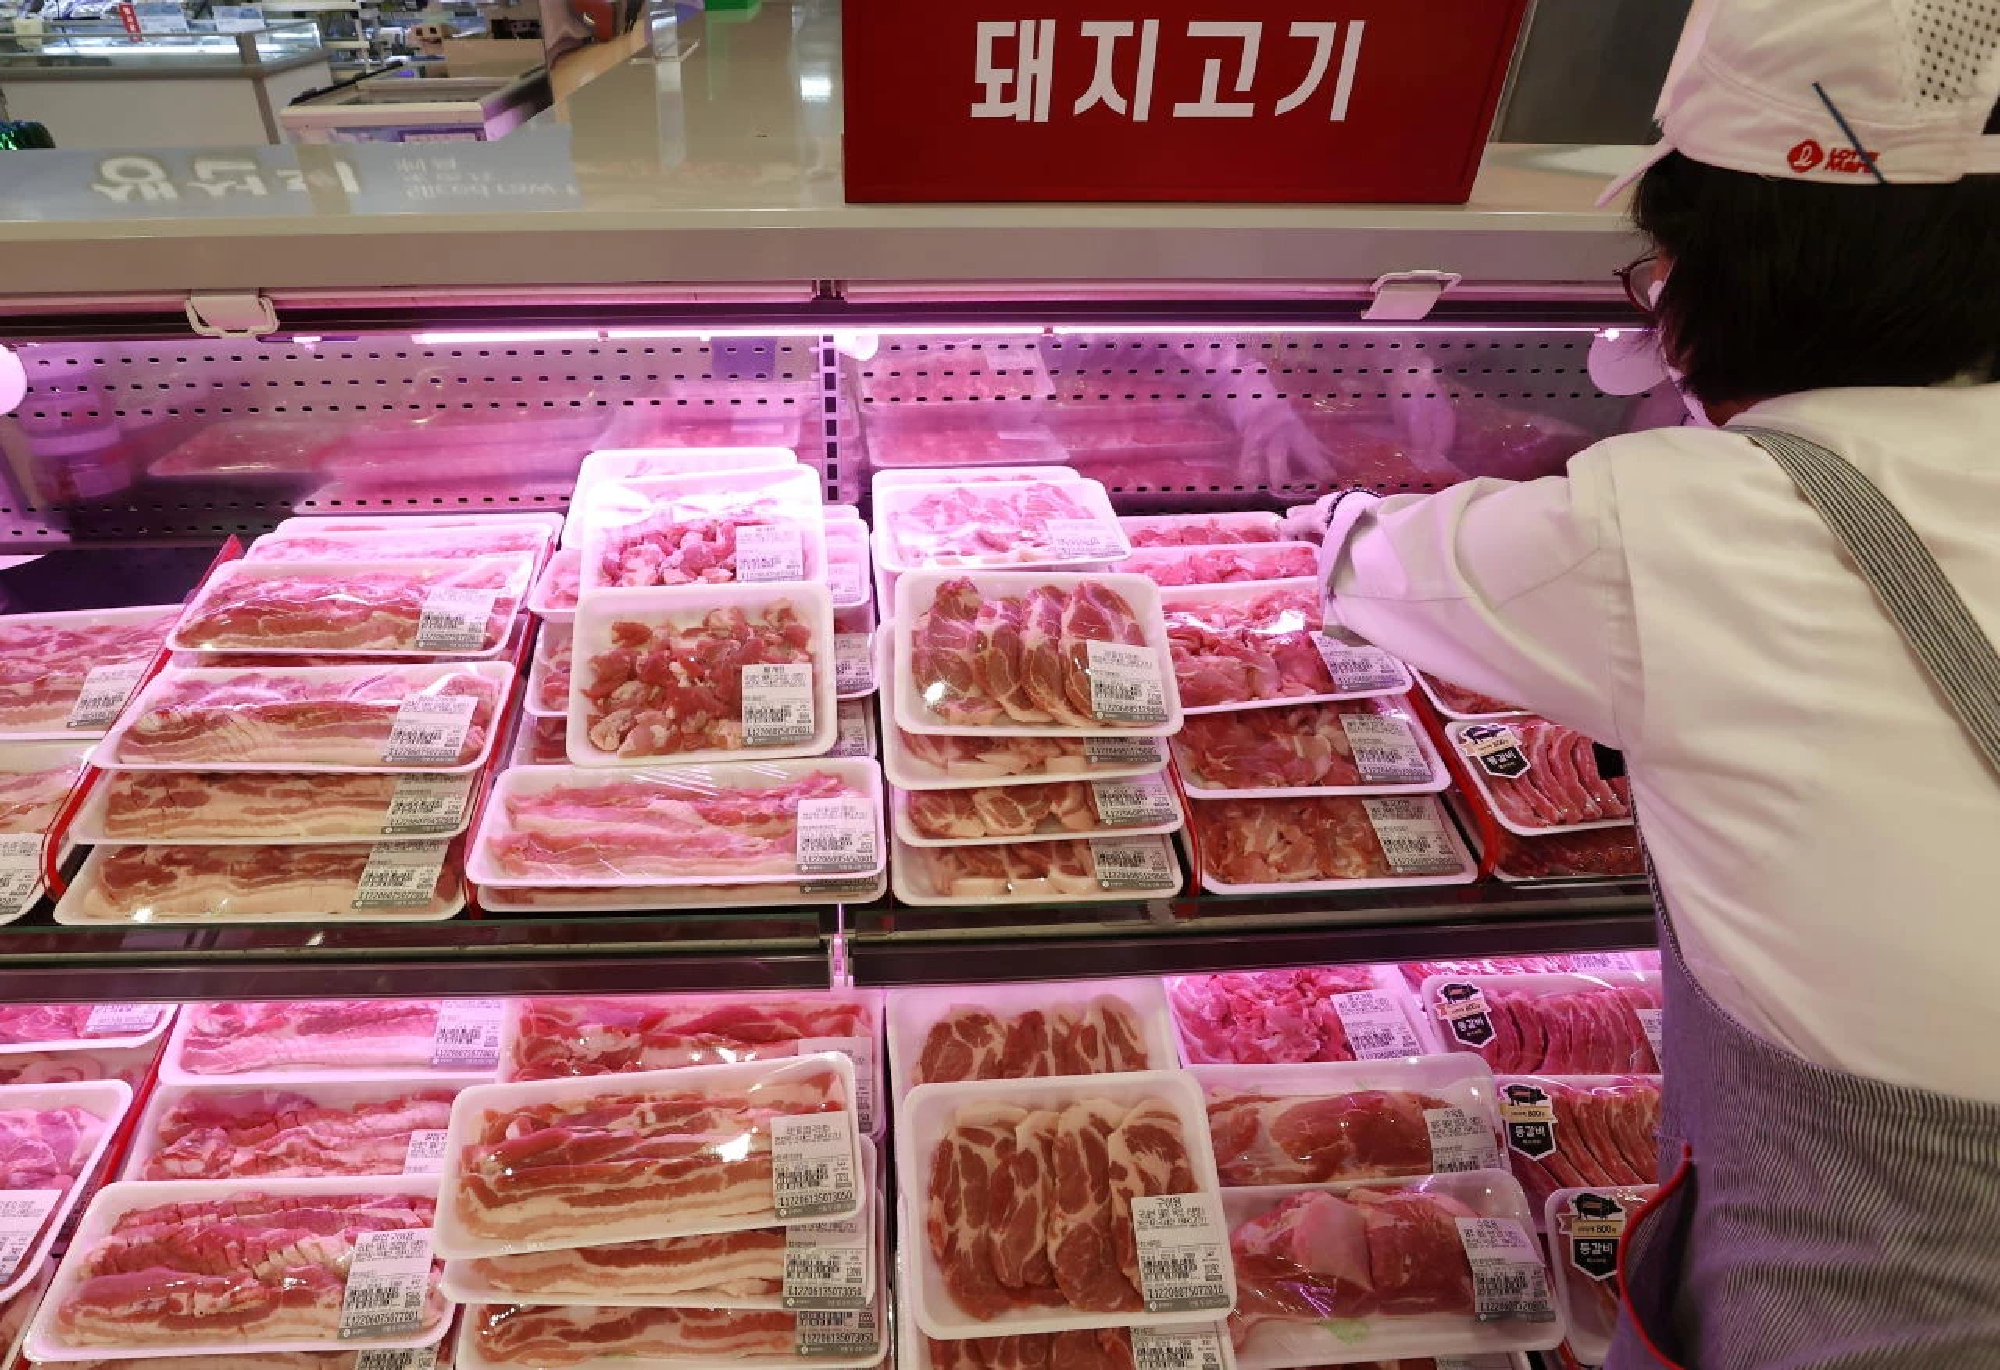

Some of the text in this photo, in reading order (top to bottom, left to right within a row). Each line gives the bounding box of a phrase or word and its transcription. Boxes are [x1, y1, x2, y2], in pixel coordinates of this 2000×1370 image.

[971, 19, 1365, 123] 돼지고기
[1457, 1018, 1485, 1032] 등갈비
[1515, 1125, 1546, 1138] 등갈비
[1580, 1242, 1613, 1255] 등갈비
